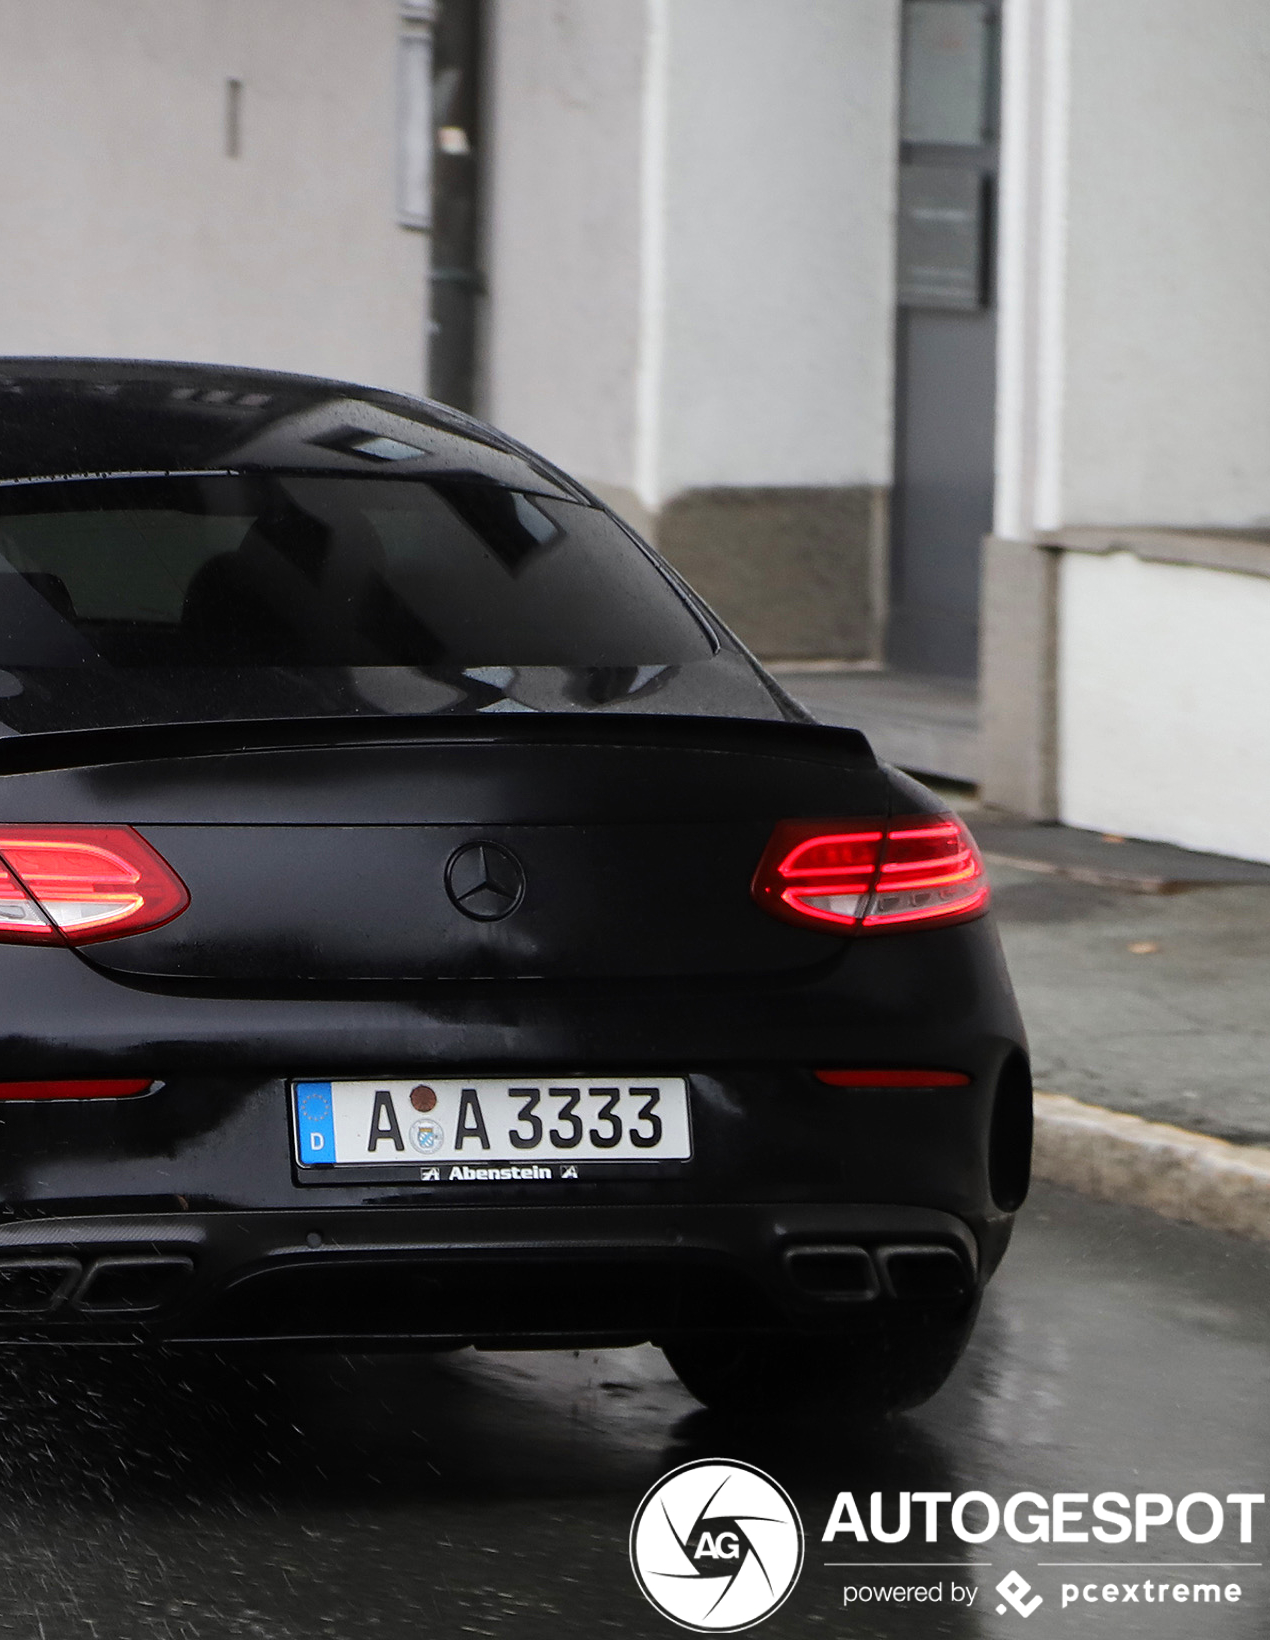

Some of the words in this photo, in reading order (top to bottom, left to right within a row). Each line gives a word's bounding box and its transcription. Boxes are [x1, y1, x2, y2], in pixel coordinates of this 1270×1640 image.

[367, 1090, 405, 1152] A
[454, 1088, 490, 1151] A
[508, 1087, 662, 1149] 3333
[310, 1132, 324, 1151] D
[448, 1165, 552, 1182] Abenstein
